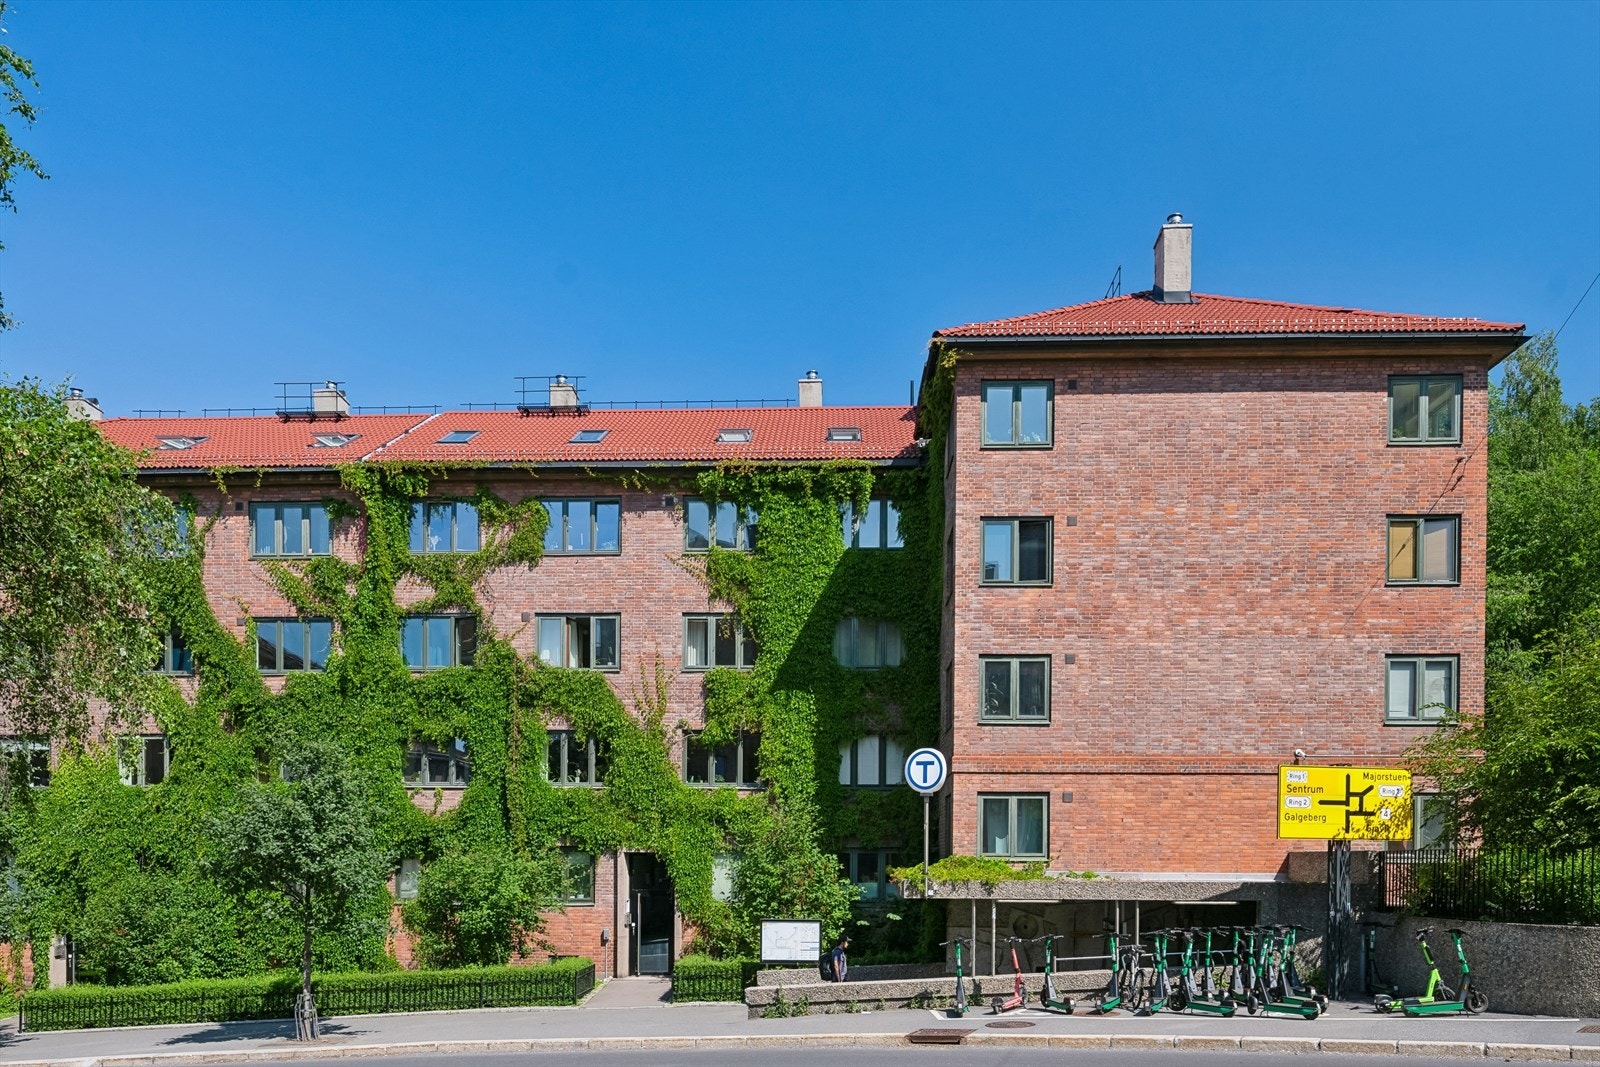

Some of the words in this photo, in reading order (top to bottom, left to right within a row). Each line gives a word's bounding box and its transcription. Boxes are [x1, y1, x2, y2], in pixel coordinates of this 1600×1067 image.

[916, 761, 934, 783] T
[1363, 772, 1407, 782] Majorstuen
[1286, 783, 1324, 794] Sentrum
[1382, 787, 1395, 795] Ring
[1288, 798, 1302, 807] Ring
[1303, 798, 1308, 806] 2
[1284, 812, 1327, 823] Galgeberg
